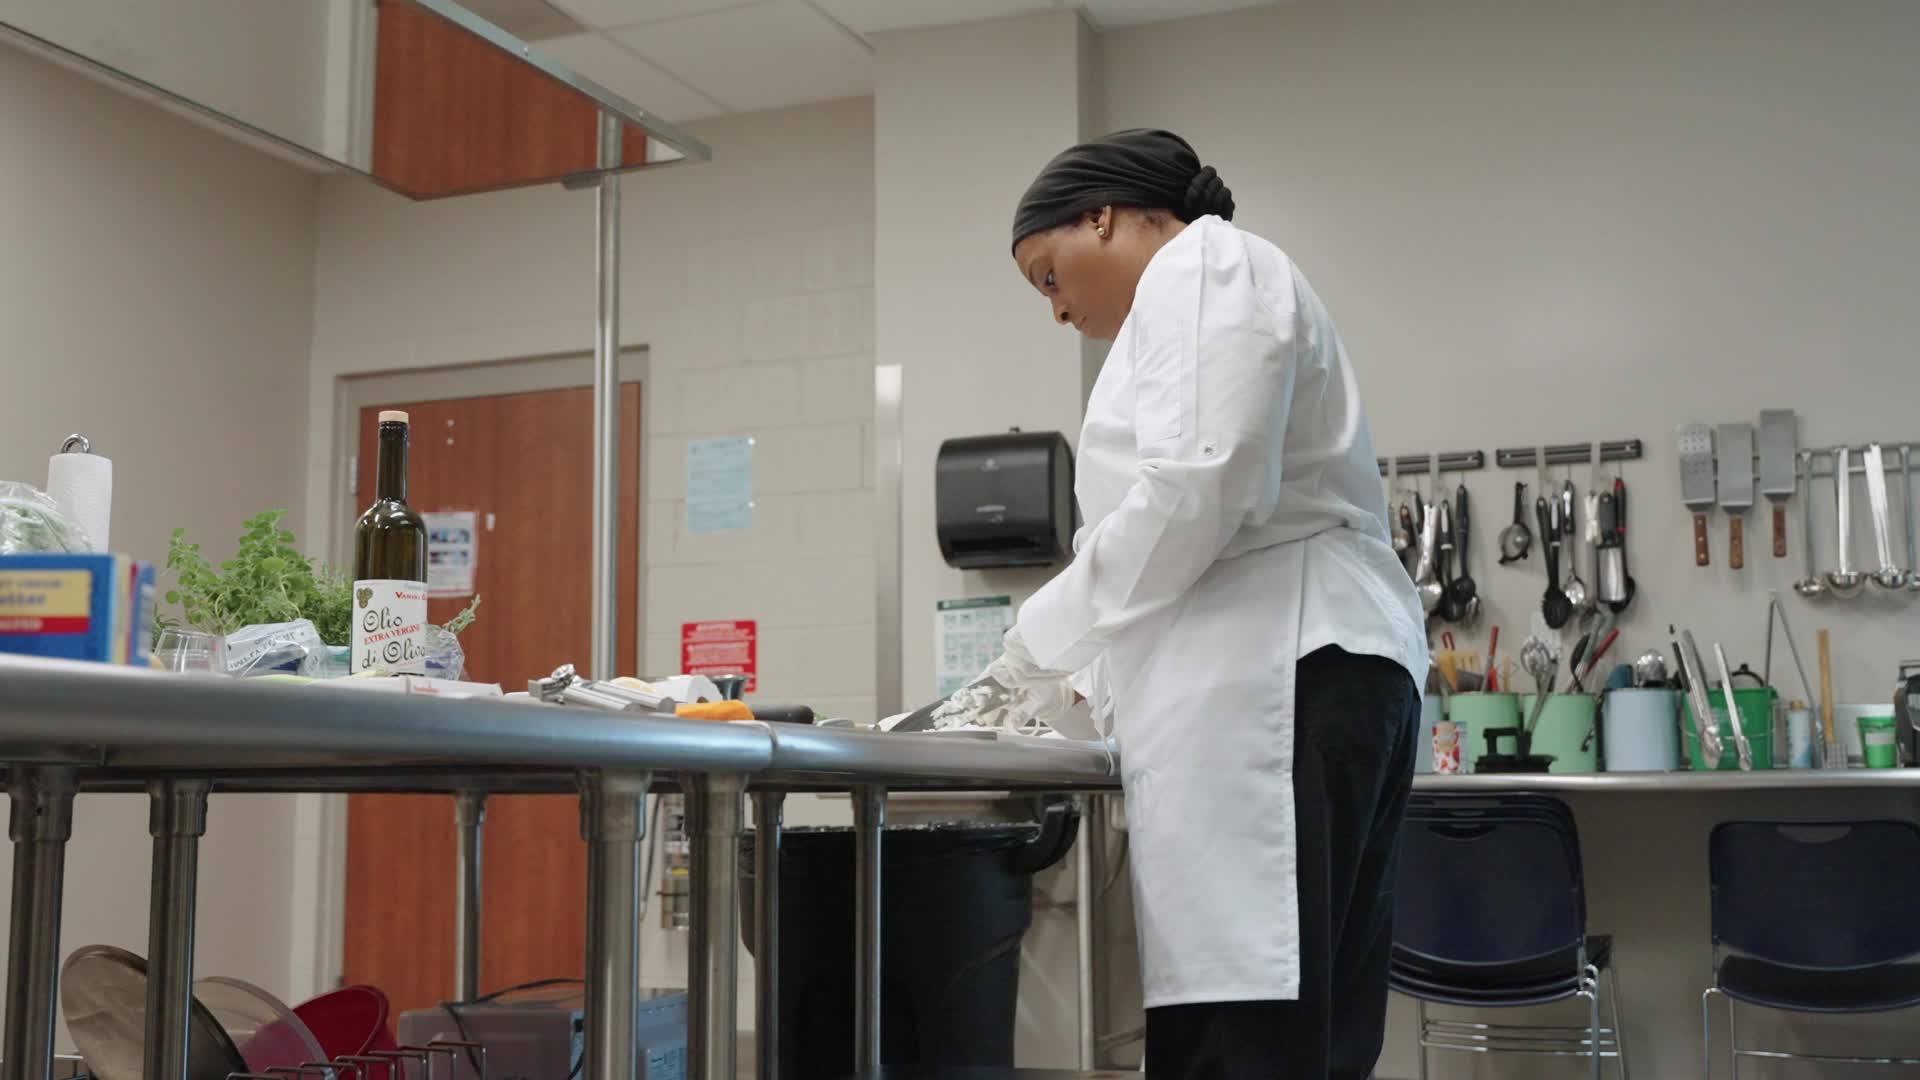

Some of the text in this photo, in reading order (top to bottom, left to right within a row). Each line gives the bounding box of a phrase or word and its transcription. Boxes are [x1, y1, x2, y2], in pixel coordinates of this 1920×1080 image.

[363, 606, 403, 633] Olio
[364, 632, 391, 646] EXTRA
[361, 648, 377, 669] di
